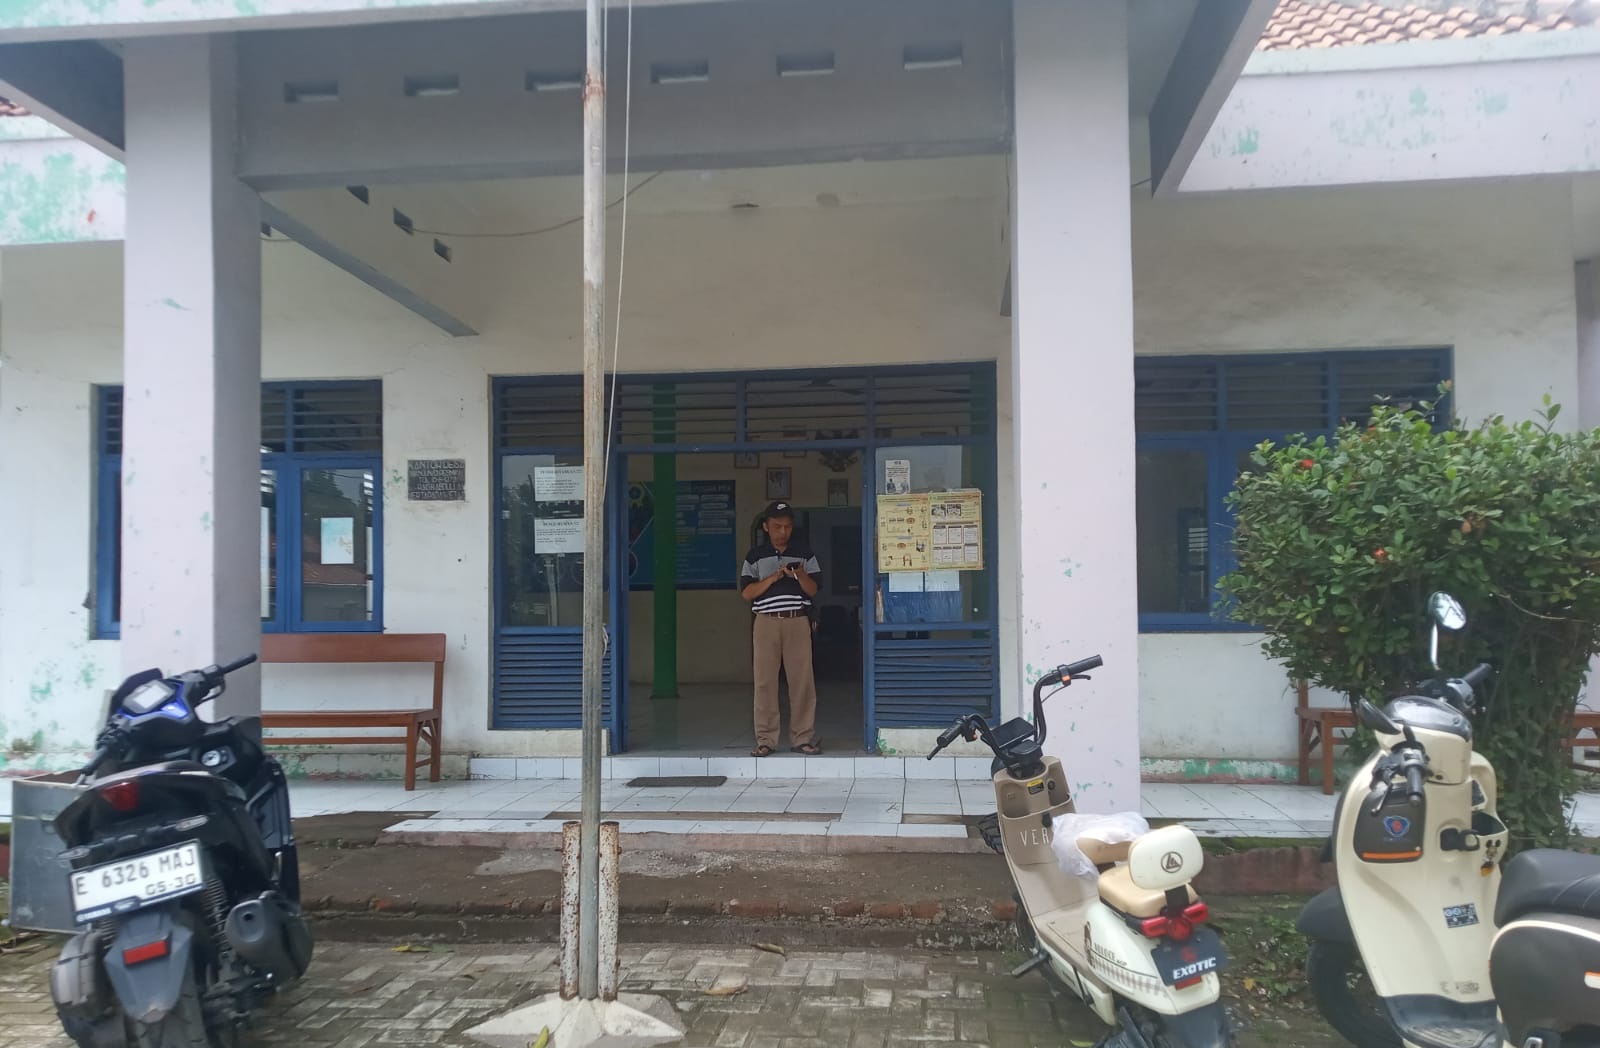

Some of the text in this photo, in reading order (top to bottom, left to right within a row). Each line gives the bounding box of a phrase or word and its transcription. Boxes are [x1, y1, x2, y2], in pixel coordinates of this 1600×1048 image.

[75, 849, 196, 896] E 6326 MAJ
[1172, 956, 1217, 980] EXOTIC
